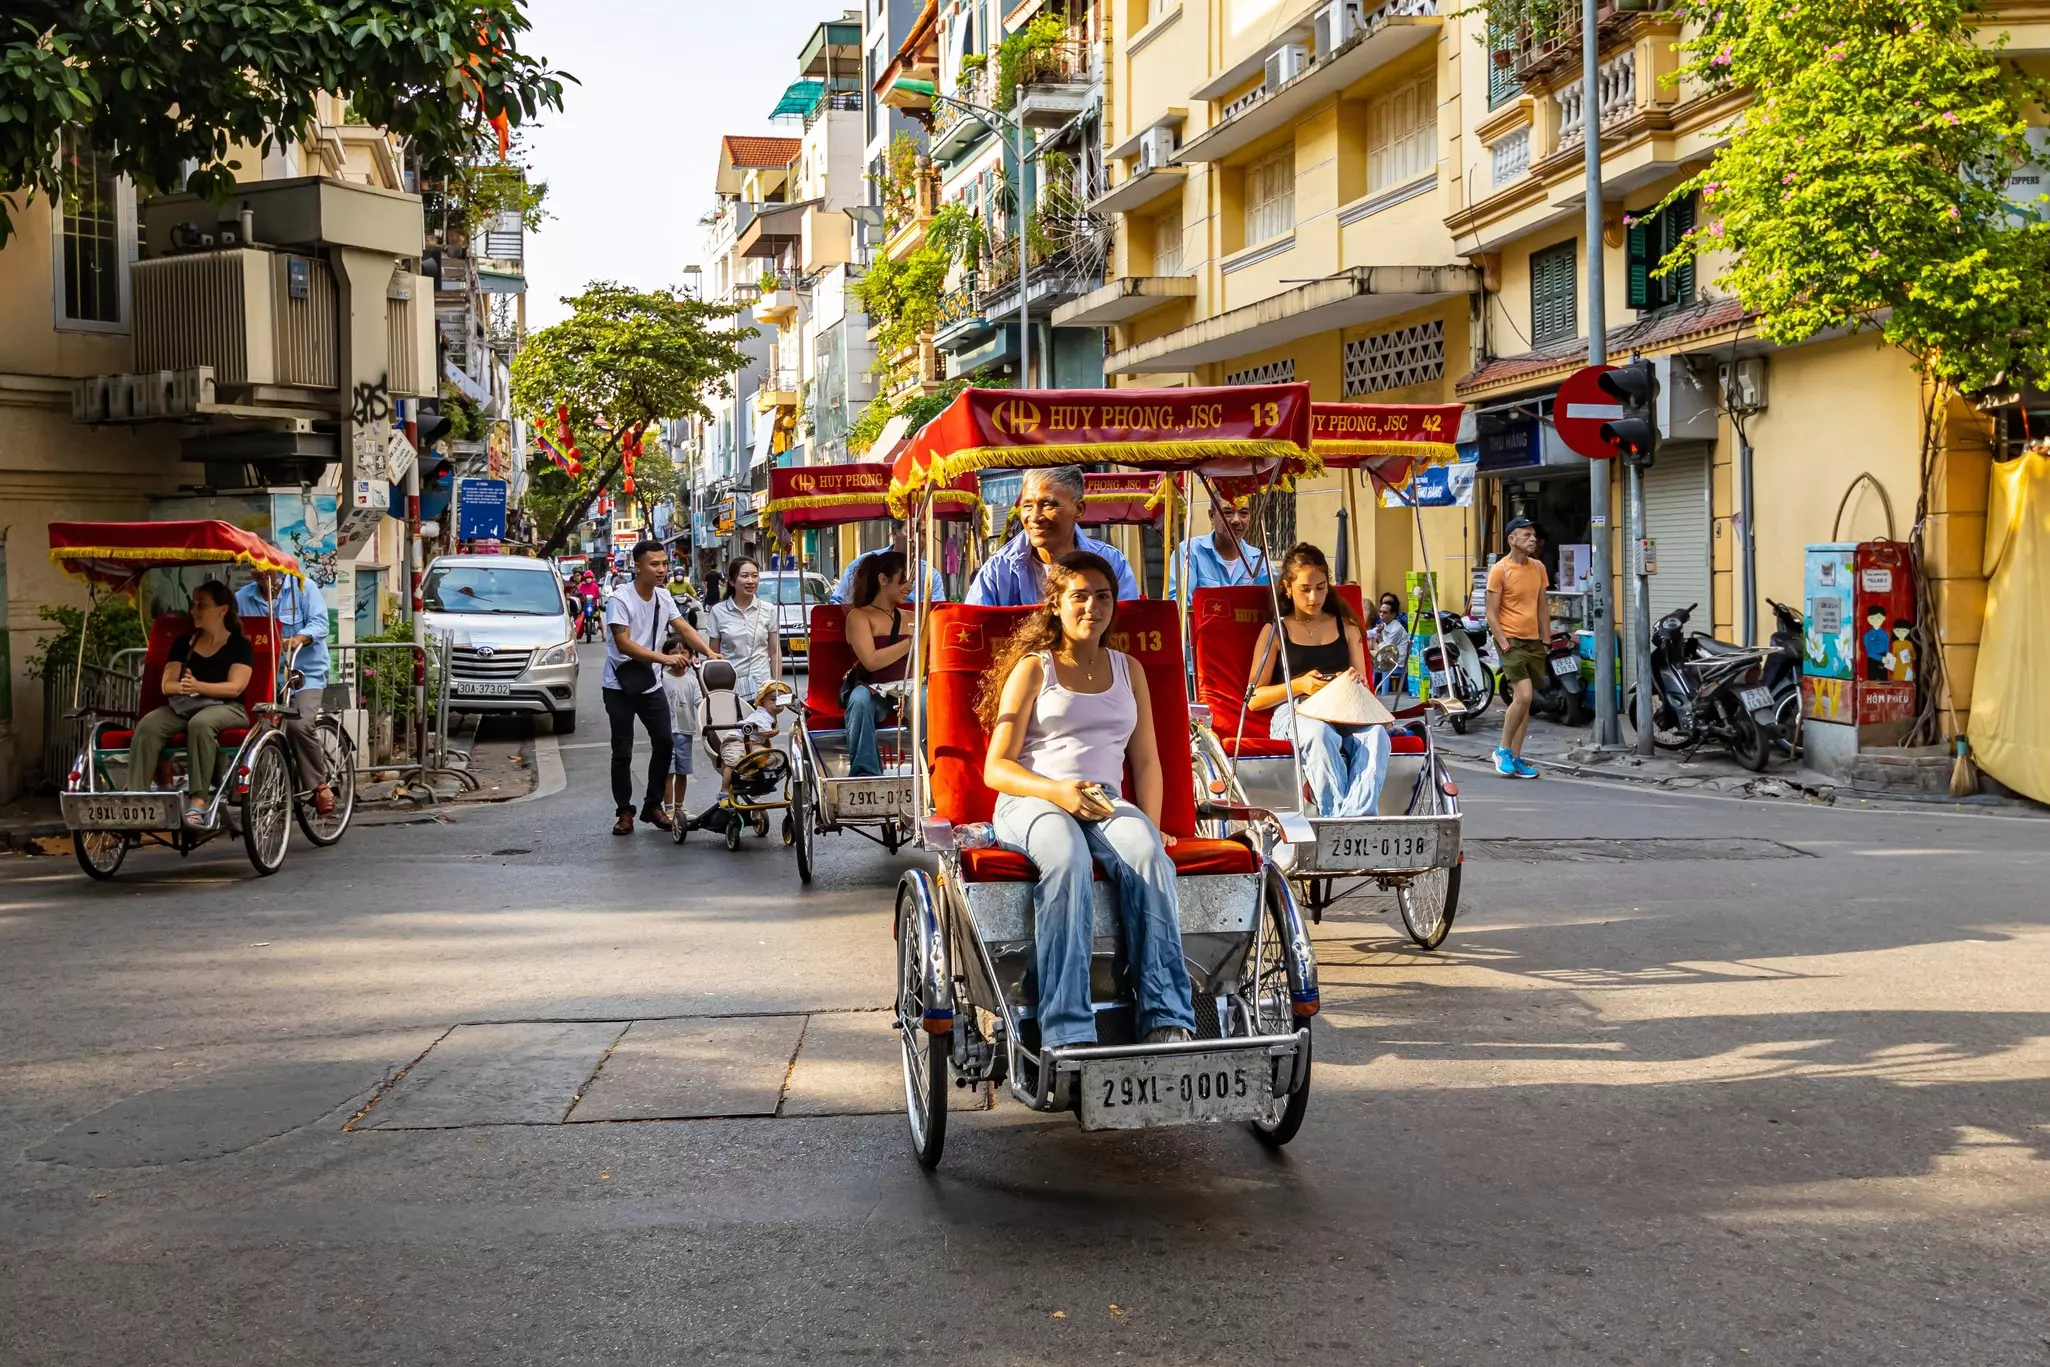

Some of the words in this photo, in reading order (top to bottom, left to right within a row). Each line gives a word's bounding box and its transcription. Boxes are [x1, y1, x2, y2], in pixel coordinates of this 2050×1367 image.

[2011, 176, 2039, 185] ZIPPERS
[1049, 406, 1094, 430] HUY
[1251, 402, 1280, 427] 13
[1422, 415, 1442, 431] 42
[819, 475, 843, 488] HUY
[255, 635, 269, 645] 24
[1137, 631, 1162, 651] 13
[460, 684, 508, 695] 30A-373.02
[1812, 679, 1842, 719] XV
